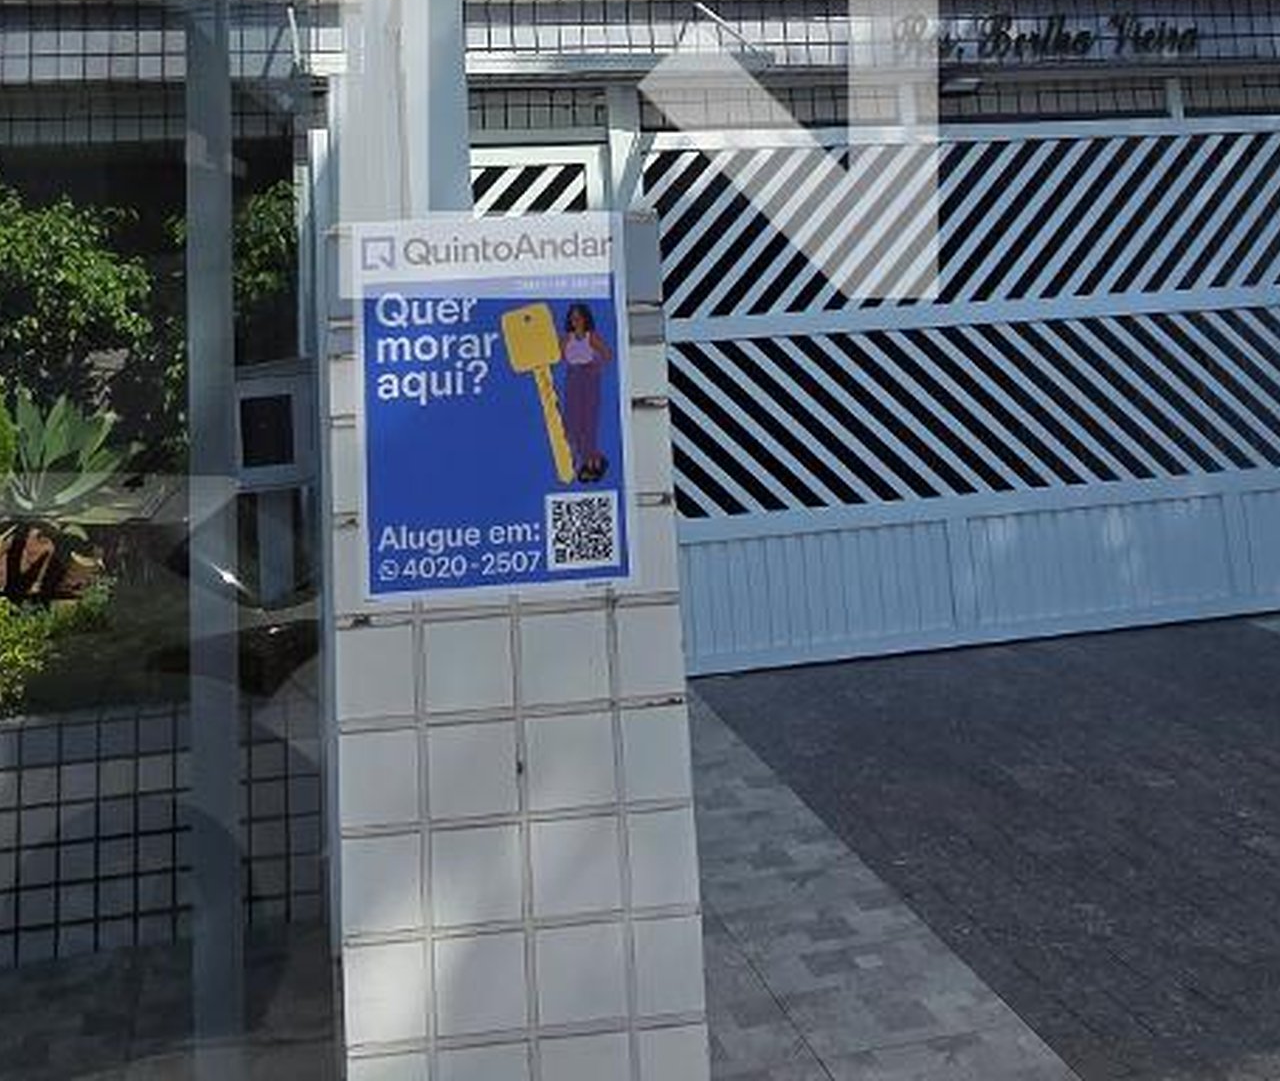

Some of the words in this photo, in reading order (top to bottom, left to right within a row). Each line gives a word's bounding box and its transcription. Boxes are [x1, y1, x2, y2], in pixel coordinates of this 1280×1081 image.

[403, 234, 611, 266] QuintoAndar
[375, 293, 478, 327] Quer
[376, 332, 499, 363] morar
[376, 360, 489, 405] aqui?
[378, 524, 481, 552] Alugue
[489, 520, 540, 542] em:
[403, 551, 541, 579] 4020-2507
